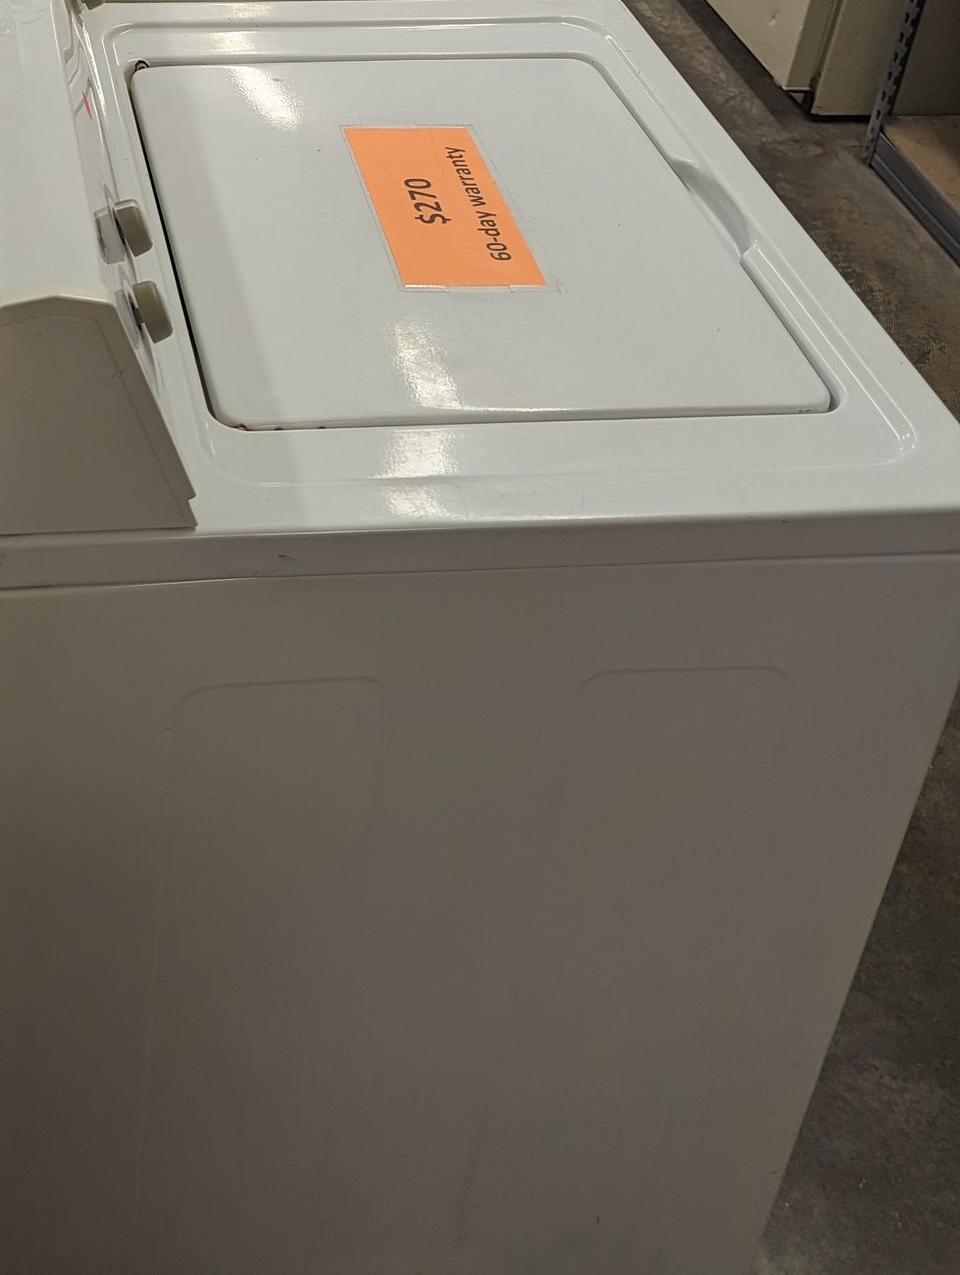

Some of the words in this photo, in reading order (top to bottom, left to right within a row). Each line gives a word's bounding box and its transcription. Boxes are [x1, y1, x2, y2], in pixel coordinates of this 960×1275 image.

[404, 178, 451, 225] $270
[445, 146, 486, 207] warranty
[476, 210, 512, 262] 60-day
